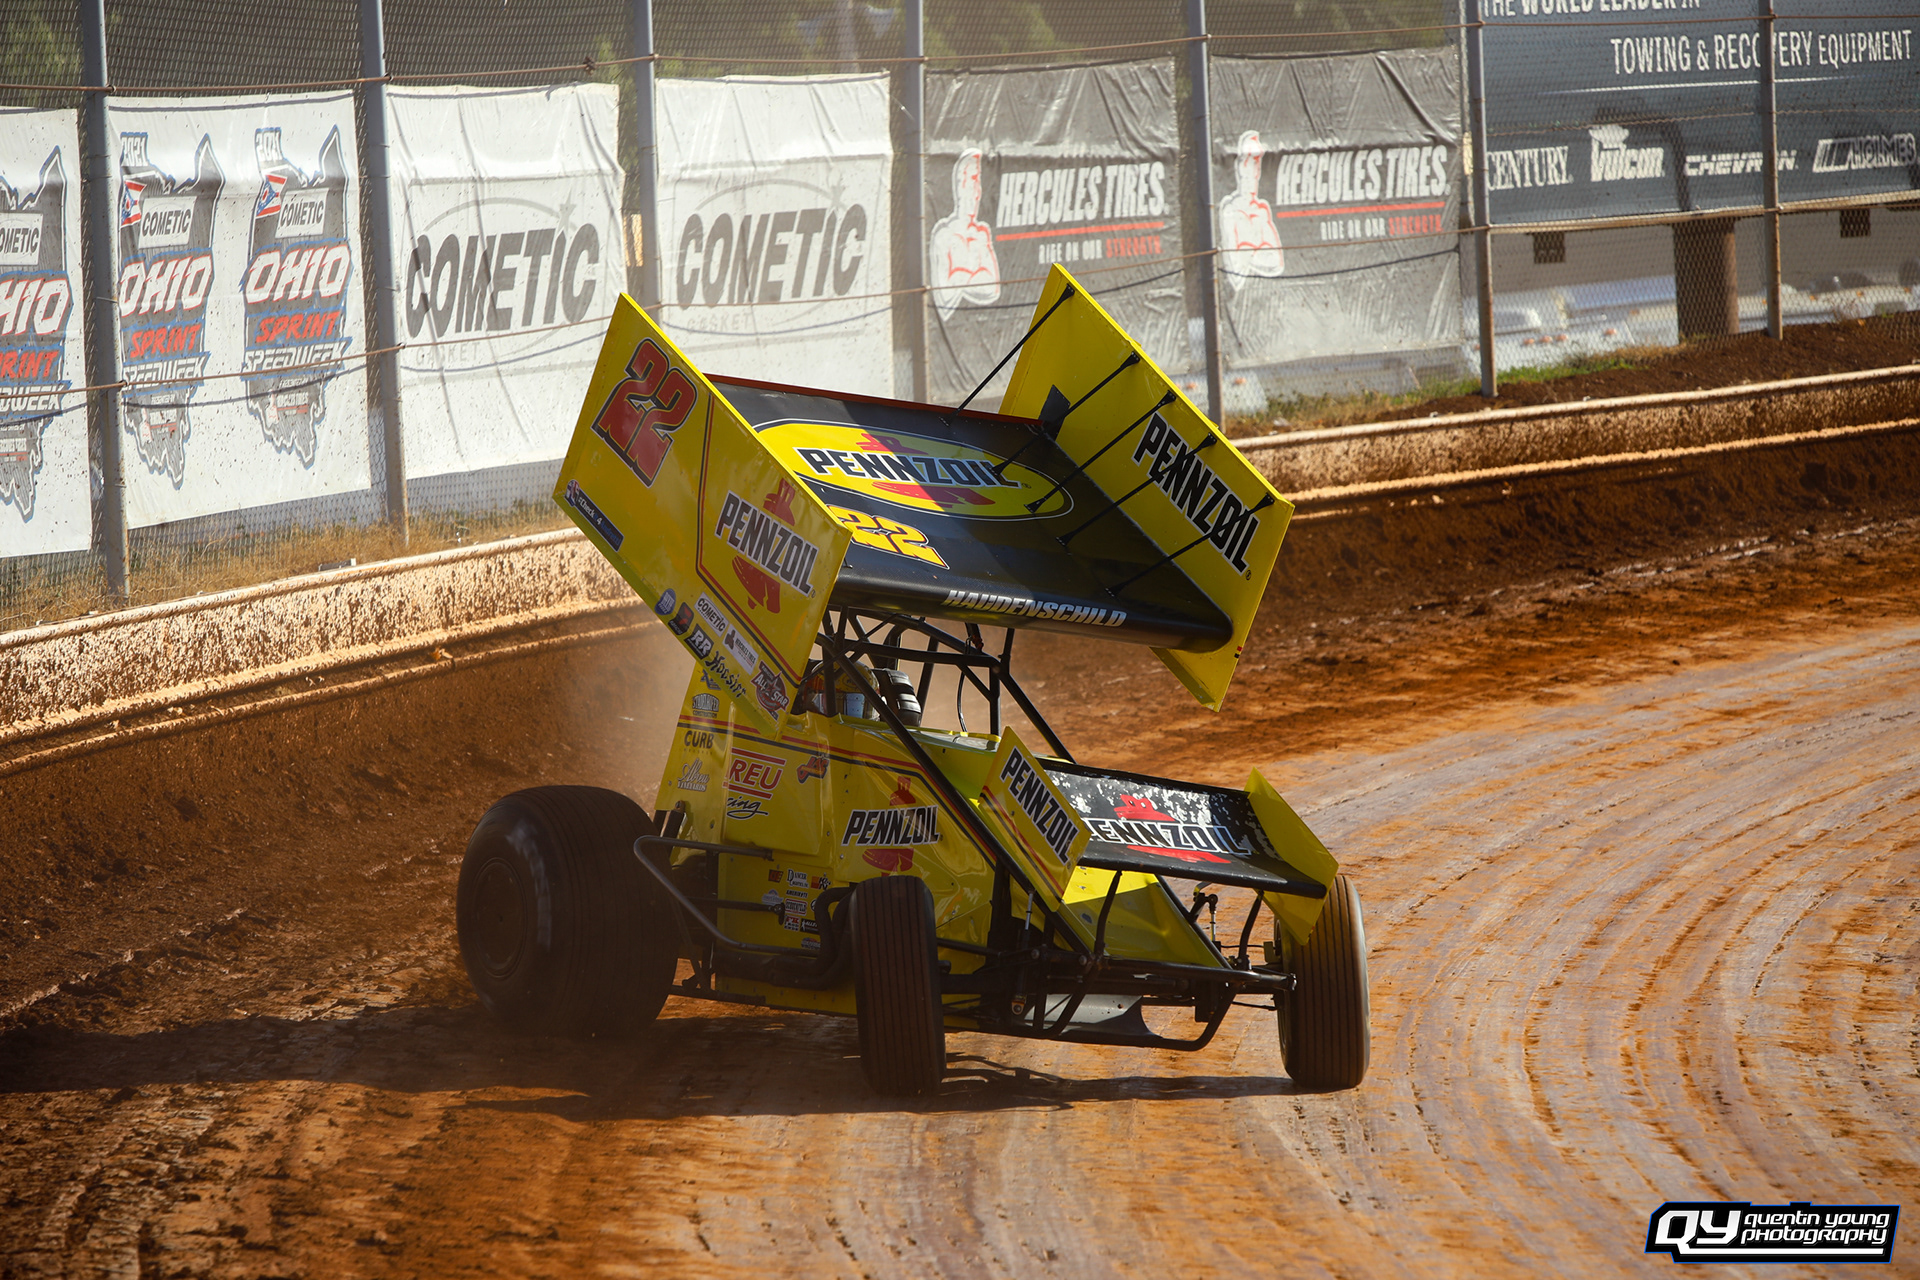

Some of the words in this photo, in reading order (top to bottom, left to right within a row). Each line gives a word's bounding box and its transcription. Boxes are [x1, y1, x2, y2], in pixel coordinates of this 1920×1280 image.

[1610, 36, 1691, 74] TOWING
[1696, 40, 1709, 71] &
[1714, 31, 1813, 70] RECOERY
[1818, 30, 1912, 69] EQUIPMENT
[121, 137, 149, 166] 2021
[1487, 146, 1569, 191] CENTURY
[1685, 151, 1796, 176] CHEVRN
[996, 166, 1103, 228] HERCULES
[1103, 161, 1165, 219] TIRES
[1276, 149, 1382, 206] HERCULES
[1386, 145, 1448, 199] TIRES
[142, 208, 191, 237] COMETIC
[280, 201, 324, 228] COMETIC
[1321, 221, 1345, 241] RIDE
[1347, 219, 1362, 238] ON
[1365, 217, 1386, 236] OUR
[676, 203, 867, 308] COMETIC
[1038, 243, 1063, 264] RIDE
[1066, 241, 1079, 262] ON
[1082, 239, 1103, 260] OUR
[119, 255, 212, 318] OHIO
[246, 245, 350, 304] OHIO
[405, 223, 599, 338] COMETIC
[130, 324, 202, 358] SPRINT
[256, 311, 341, 343] SPRINT
[122, 355, 210, 391] SPEEDWEEK
[243, 342, 347, 374] SPEEDWEEK
[591, 337, 697, 488] 22
[793, 447, 1021, 489] PENNZOIL
[1131, 410, 1261, 576] PENNZOIL
[714, 490, 819, 598] PENNZOIL
[826, 503, 950, 570] 22
[697, 597, 726, 632] COMETIC
[941, 589, 1127, 629] HAUDENSCHILD
[771, 690, 788, 707] STAR
[684, 730, 714, 749] CURB
[1000, 745, 1080, 865] PENNZOIL
[842, 805, 940, 846] PENNZOIL
[1082, 817, 1252, 857] ENNZOIL
